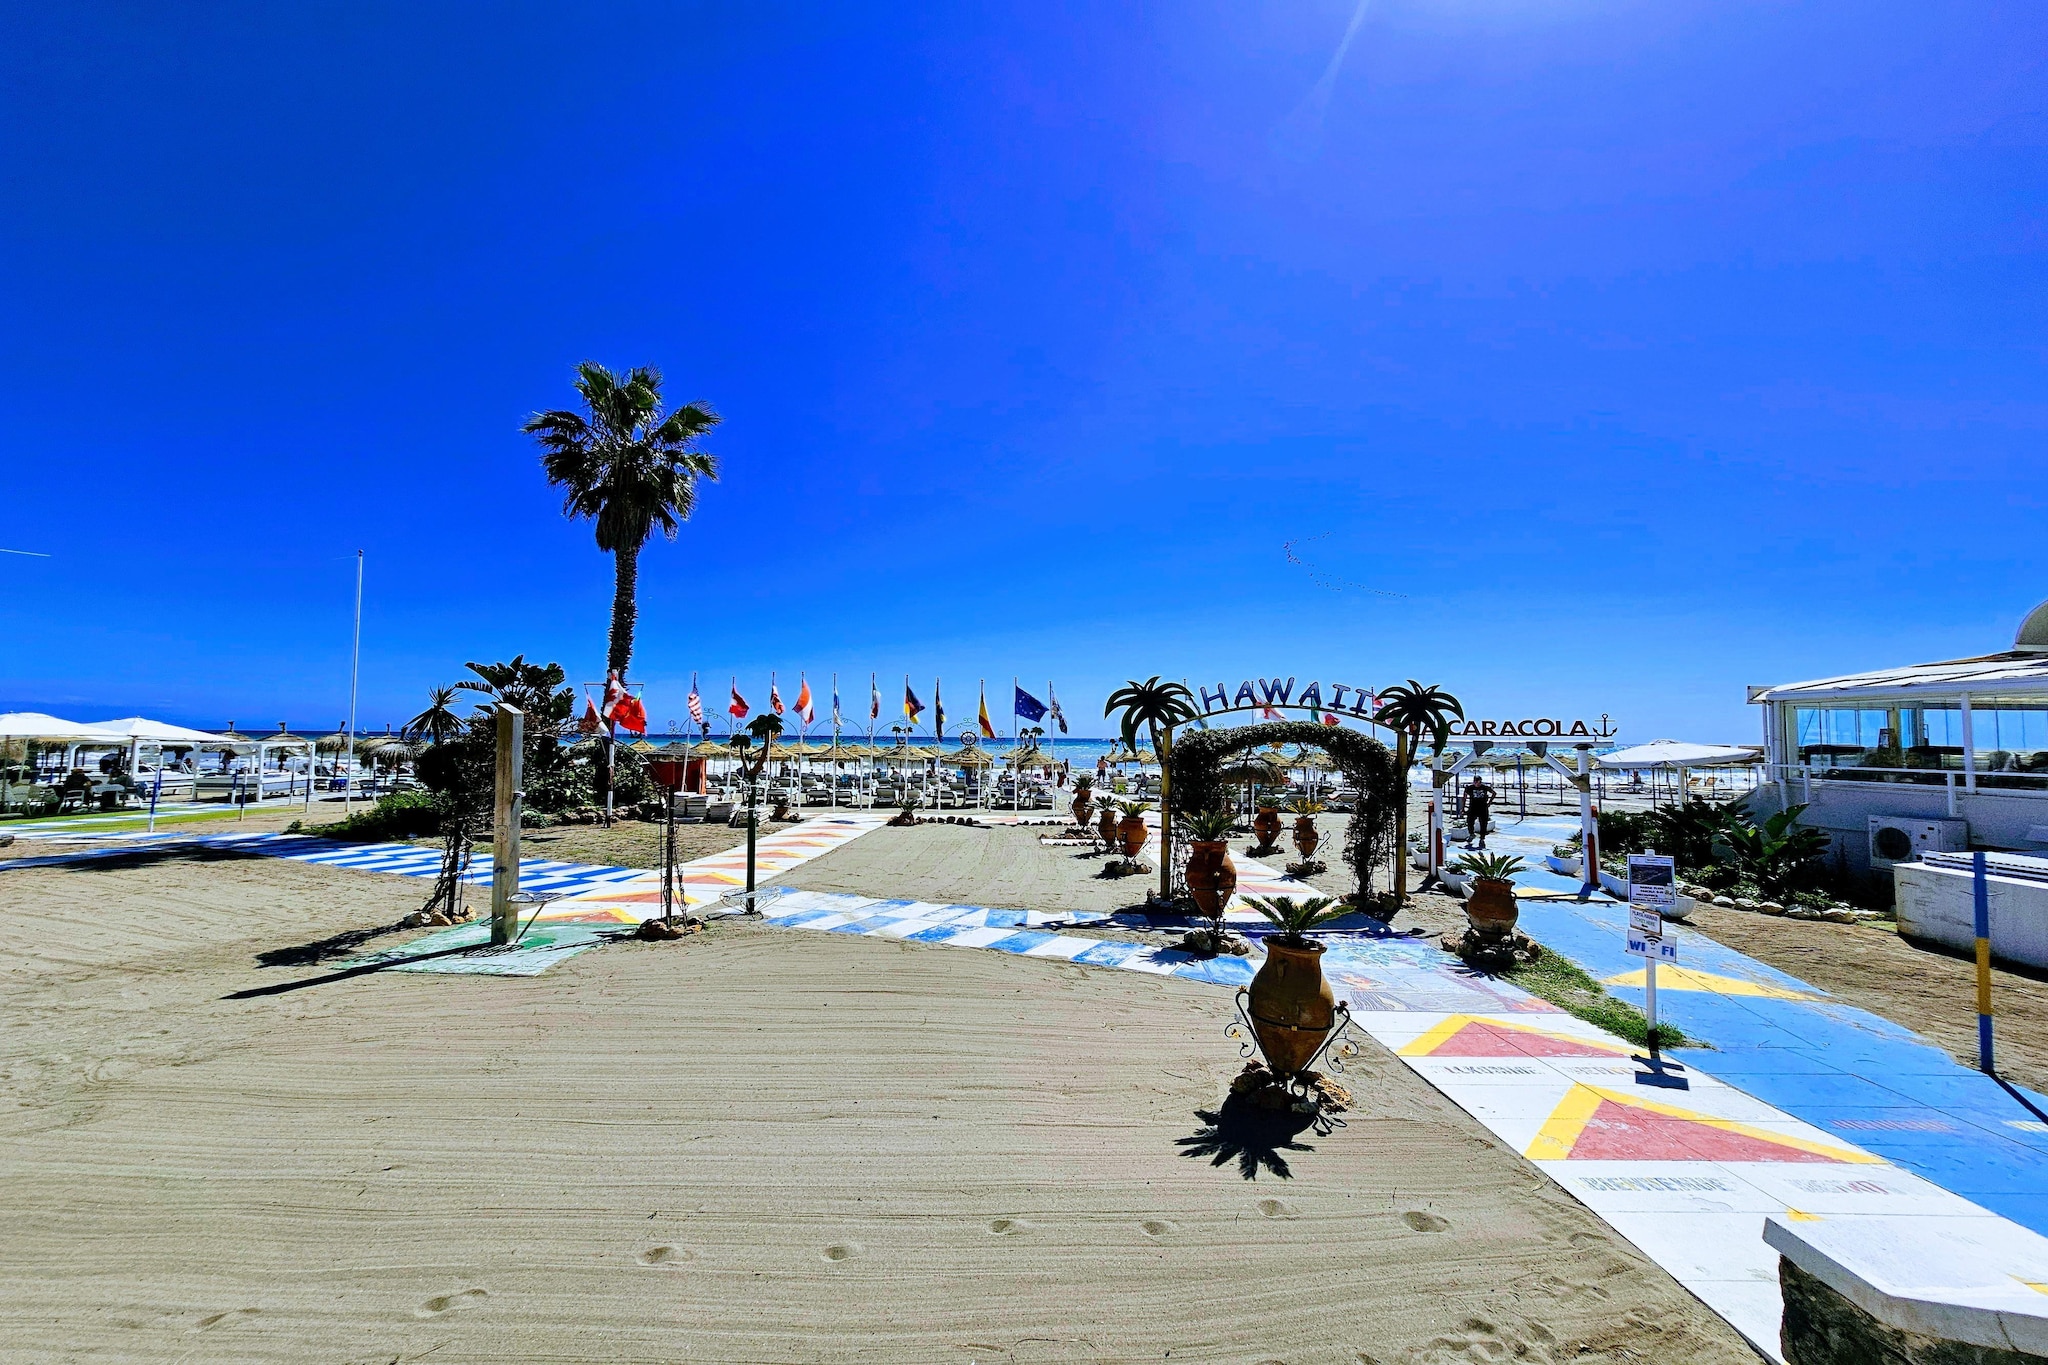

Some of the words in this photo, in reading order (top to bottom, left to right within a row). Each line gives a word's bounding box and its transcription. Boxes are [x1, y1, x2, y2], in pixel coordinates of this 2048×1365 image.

[1199, 676, 1374, 714] HAWAII
[1447, 718, 1589, 736] CARACOLA
[1629, 940, 1646, 952] WI
[1662, 945, 1674, 957] FI
